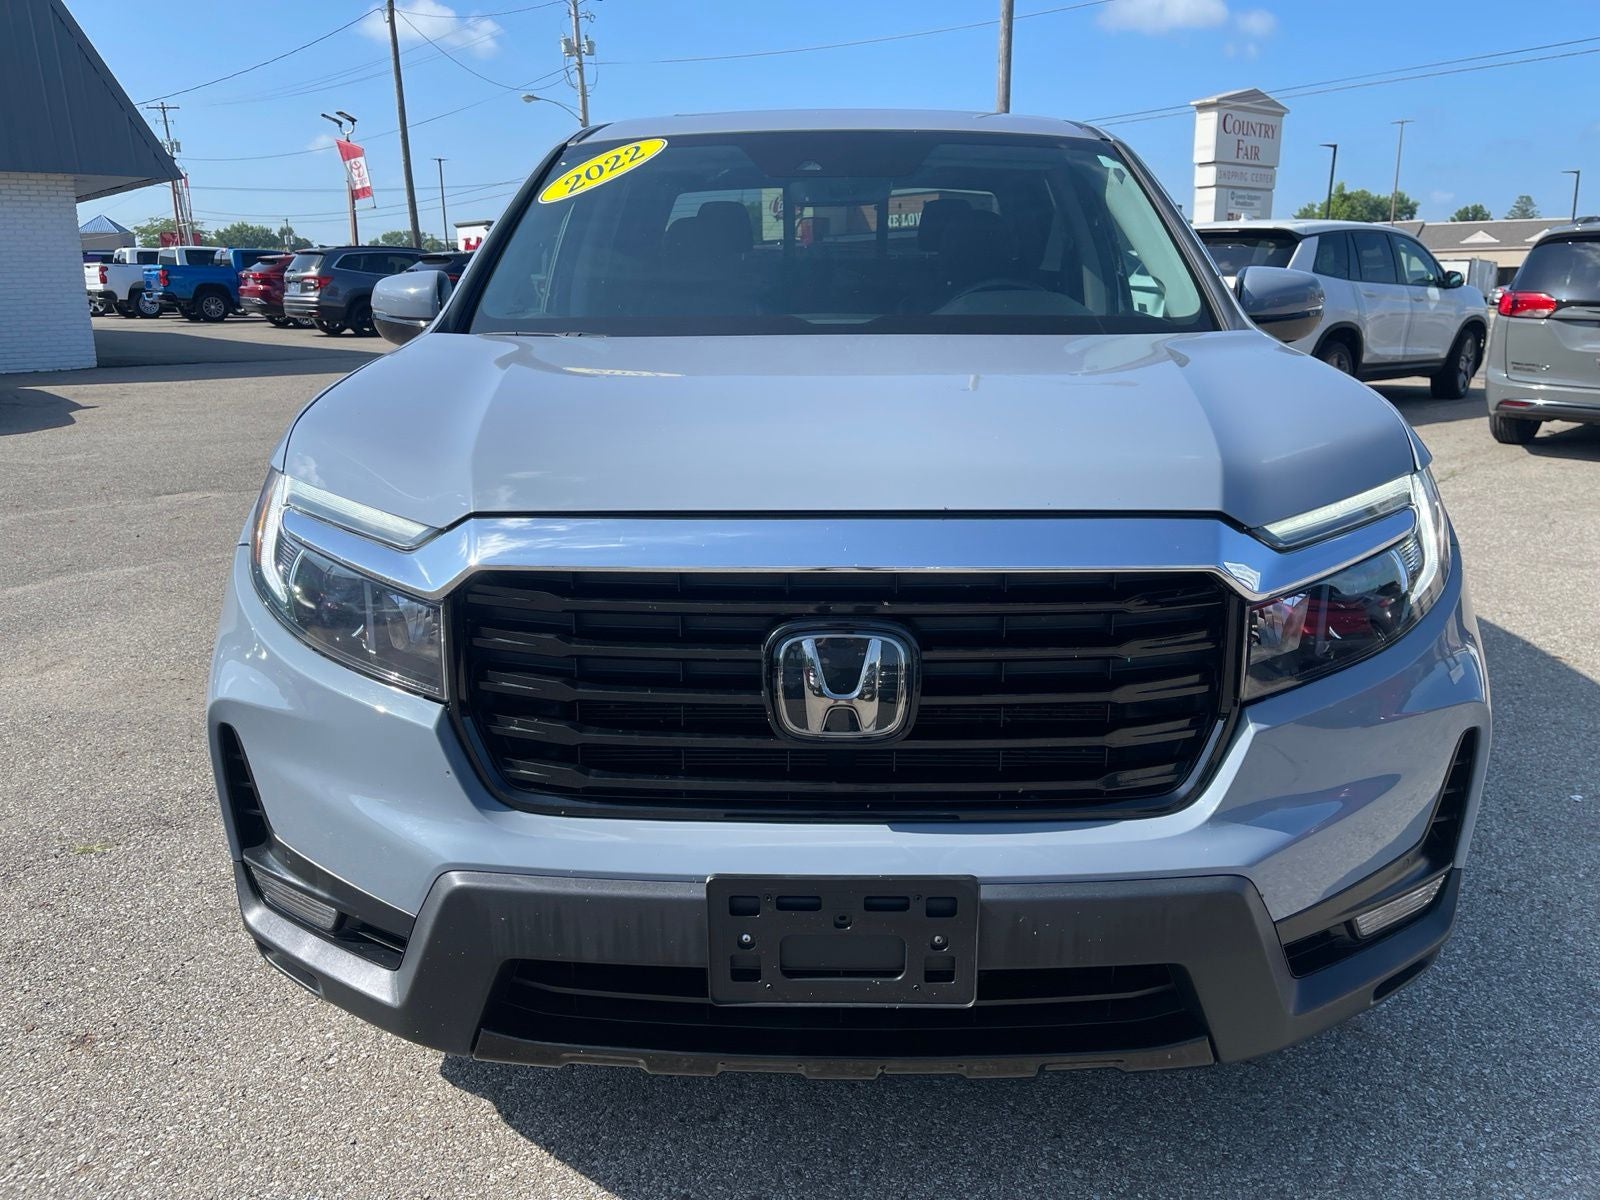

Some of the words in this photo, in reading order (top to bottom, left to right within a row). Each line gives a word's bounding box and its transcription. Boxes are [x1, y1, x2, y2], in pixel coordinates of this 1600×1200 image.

[1222, 112, 1277, 139] COUNTRY
[1235, 138, 1261, 161] FAIR
[564, 145, 646, 194] 2022
